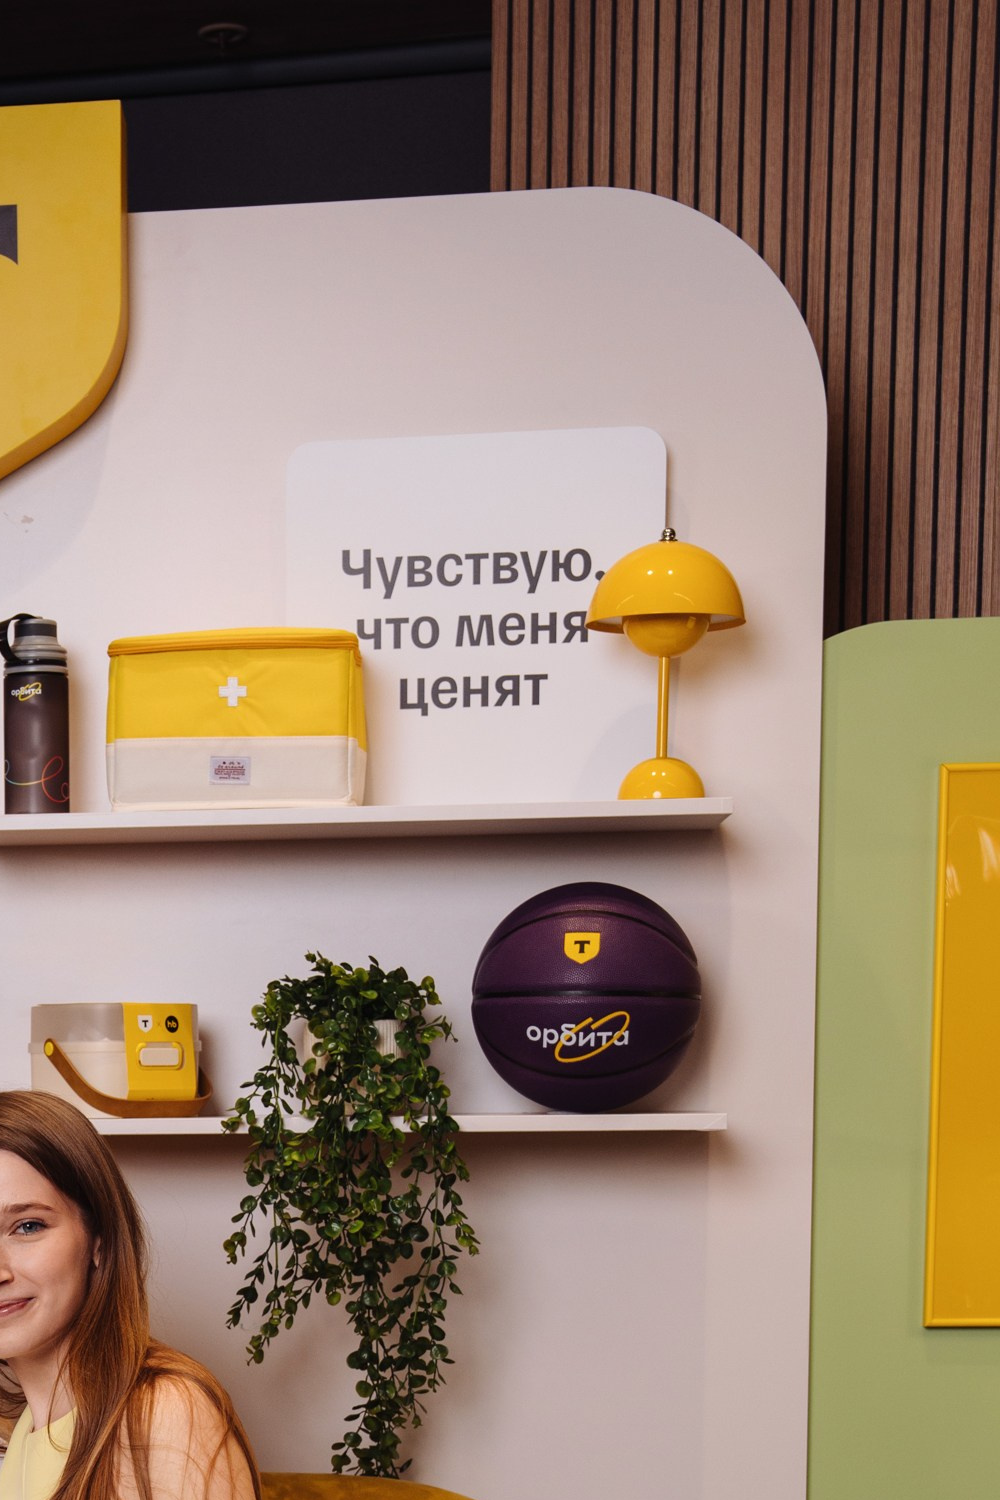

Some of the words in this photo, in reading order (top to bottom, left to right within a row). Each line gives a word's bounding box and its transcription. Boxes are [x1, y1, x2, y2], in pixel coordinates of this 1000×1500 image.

[356, 614, 440, 650] что
[455, 610, 590, 648] меня
[399, 673, 549, 717] ценят
[526, 1023, 629, 1048] орбита
